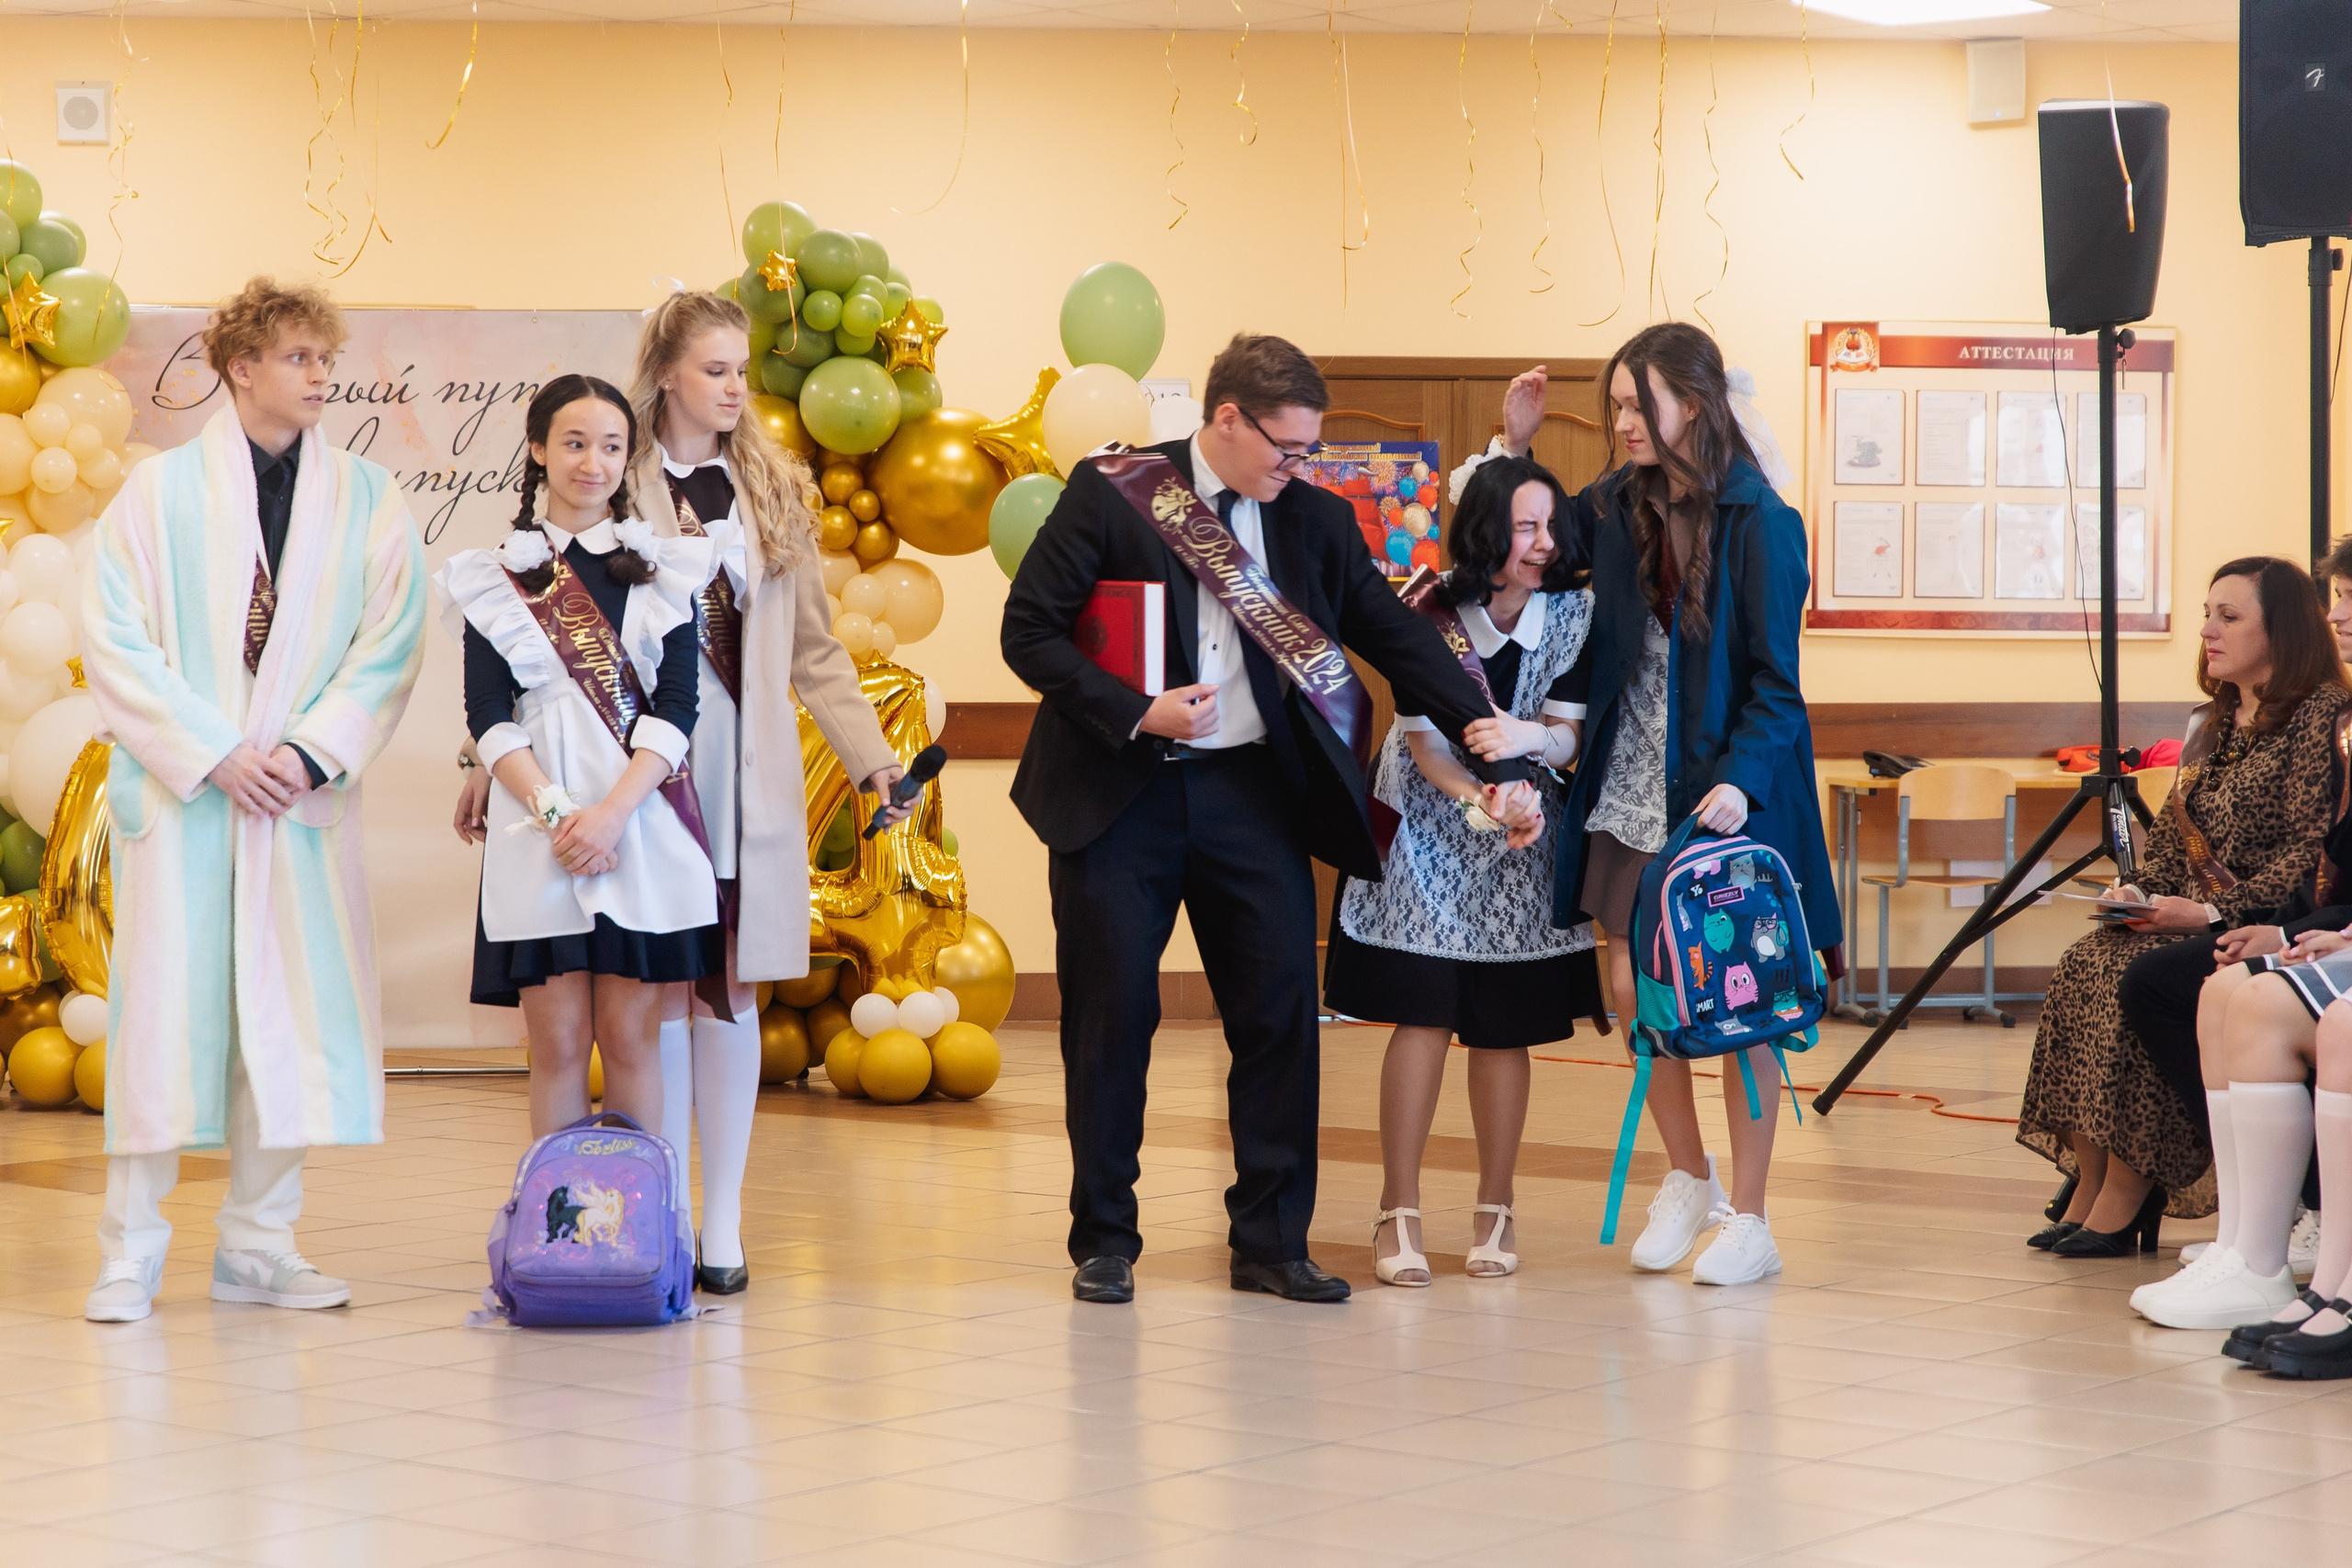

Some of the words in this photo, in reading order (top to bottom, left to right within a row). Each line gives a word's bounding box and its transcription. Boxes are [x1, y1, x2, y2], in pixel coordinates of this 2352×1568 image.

[1958, 344, 2075, 362] АТТЕСТАЦИЯ
[432, 380, 540, 457] пут
[1182, 516, 1306, 651] Выпускник
[1292, 637, 1353, 695] 2024
[551, 592, 639, 727] Выпускниц
[1713, 890, 1739, 900] GRIZZLY
